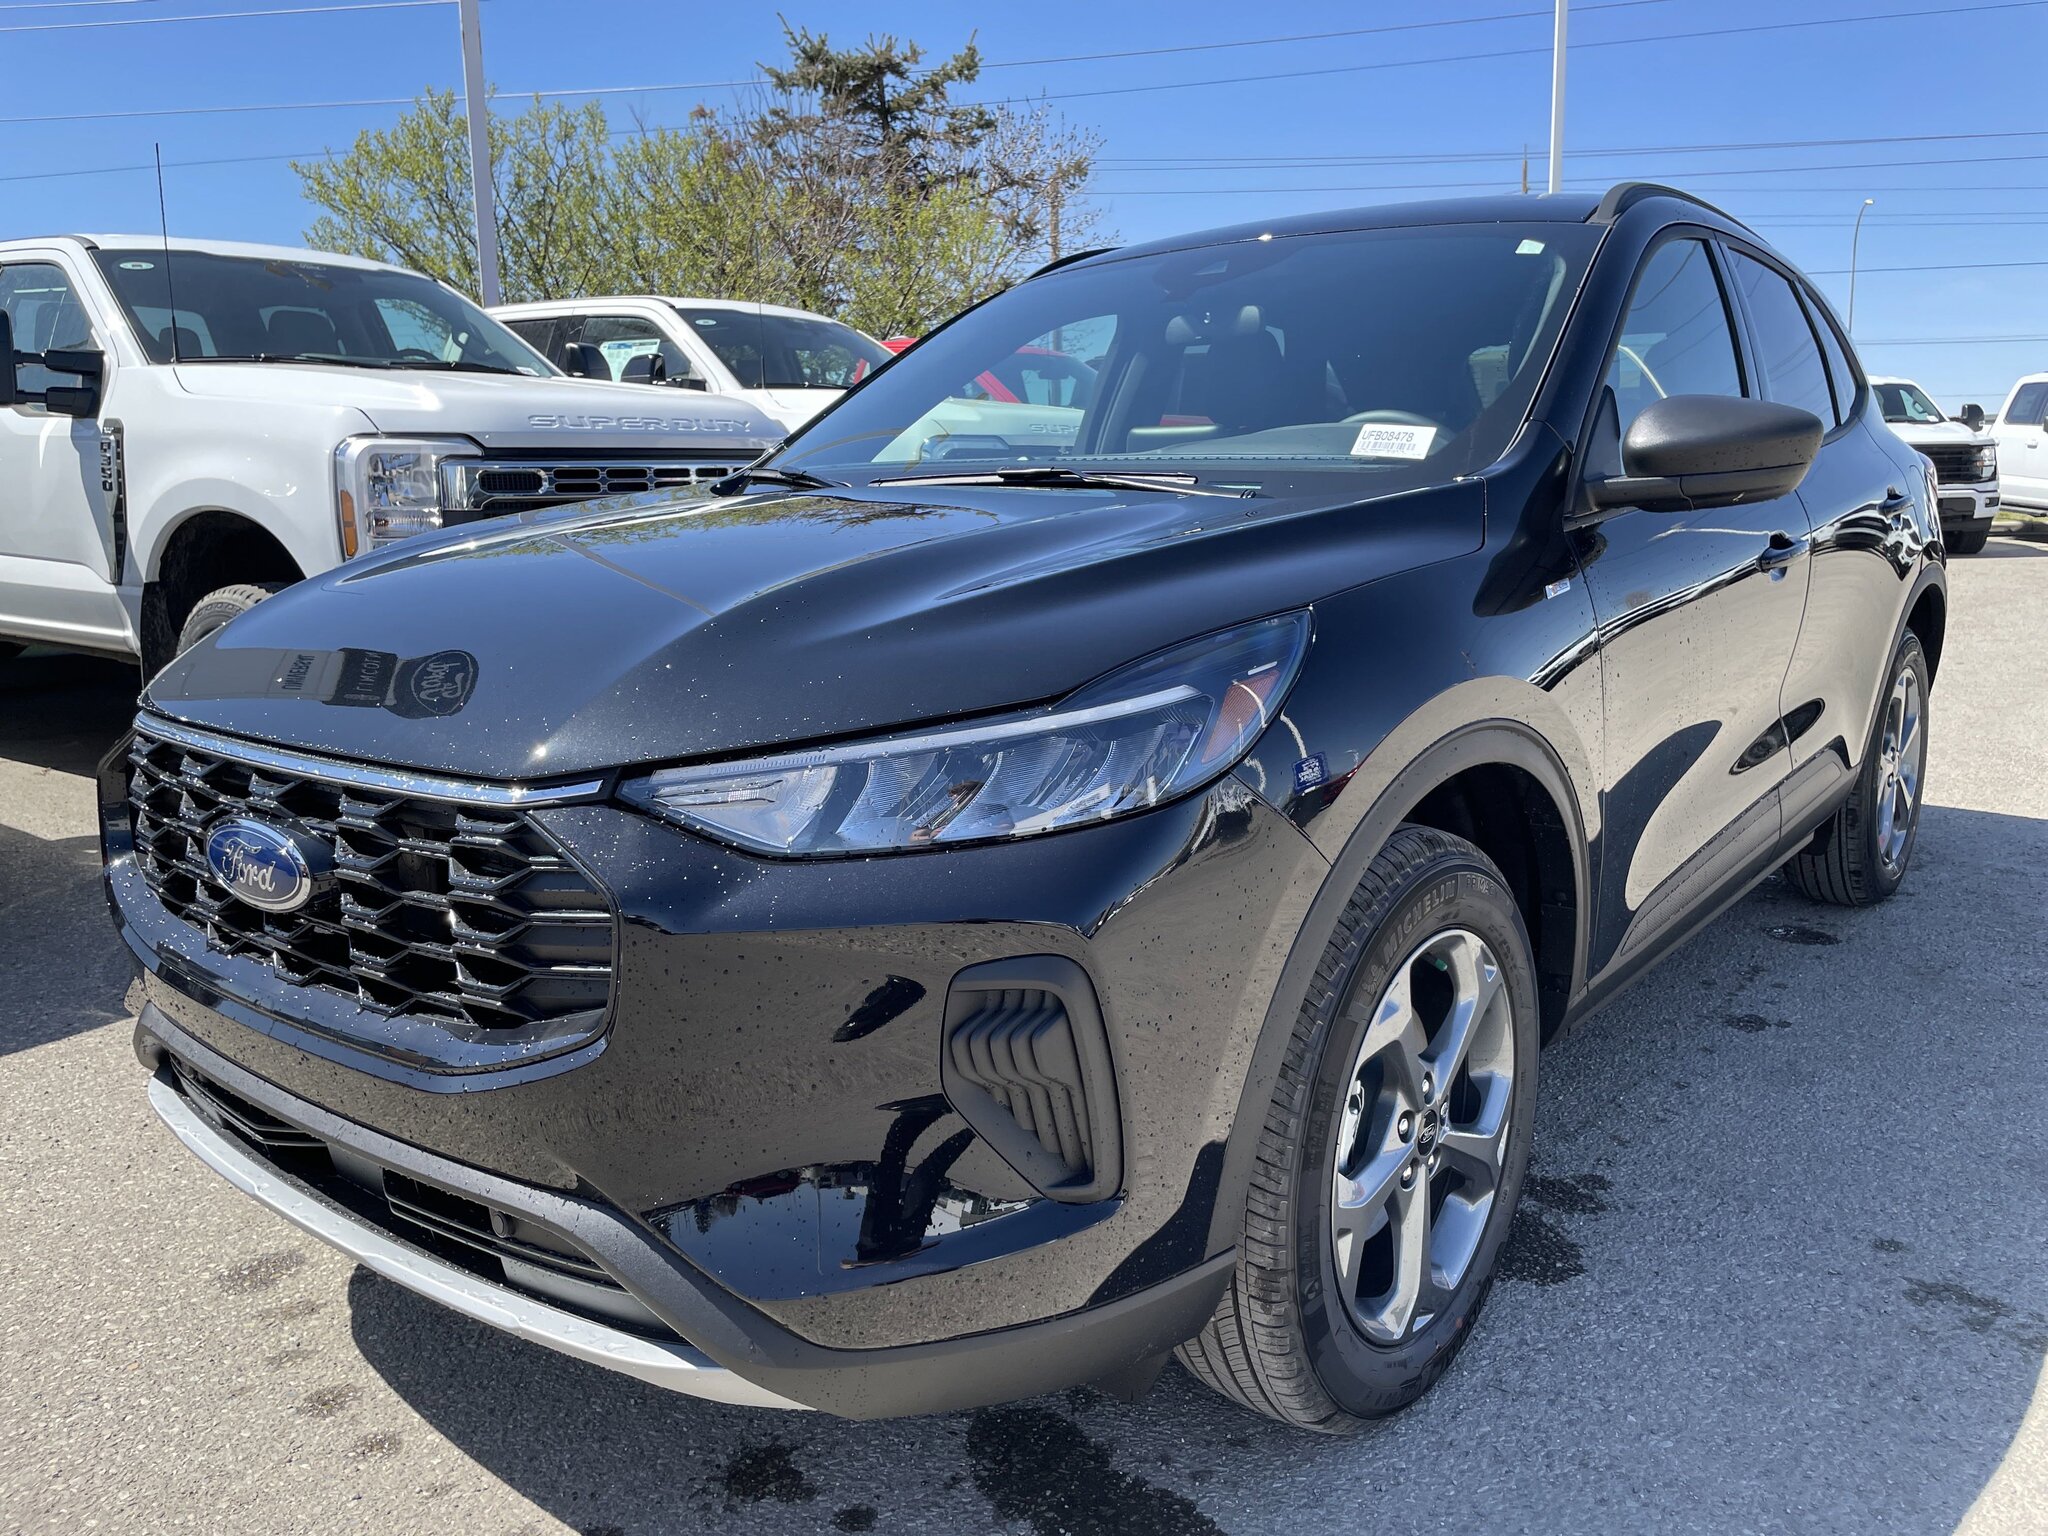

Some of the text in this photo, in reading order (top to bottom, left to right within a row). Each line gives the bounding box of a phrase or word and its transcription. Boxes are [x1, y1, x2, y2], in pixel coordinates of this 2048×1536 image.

[528, 414, 751, 433] SUPER DUTY
[222, 836, 277, 893] Ford
[1384, 879, 1457, 964] MICHELIN
